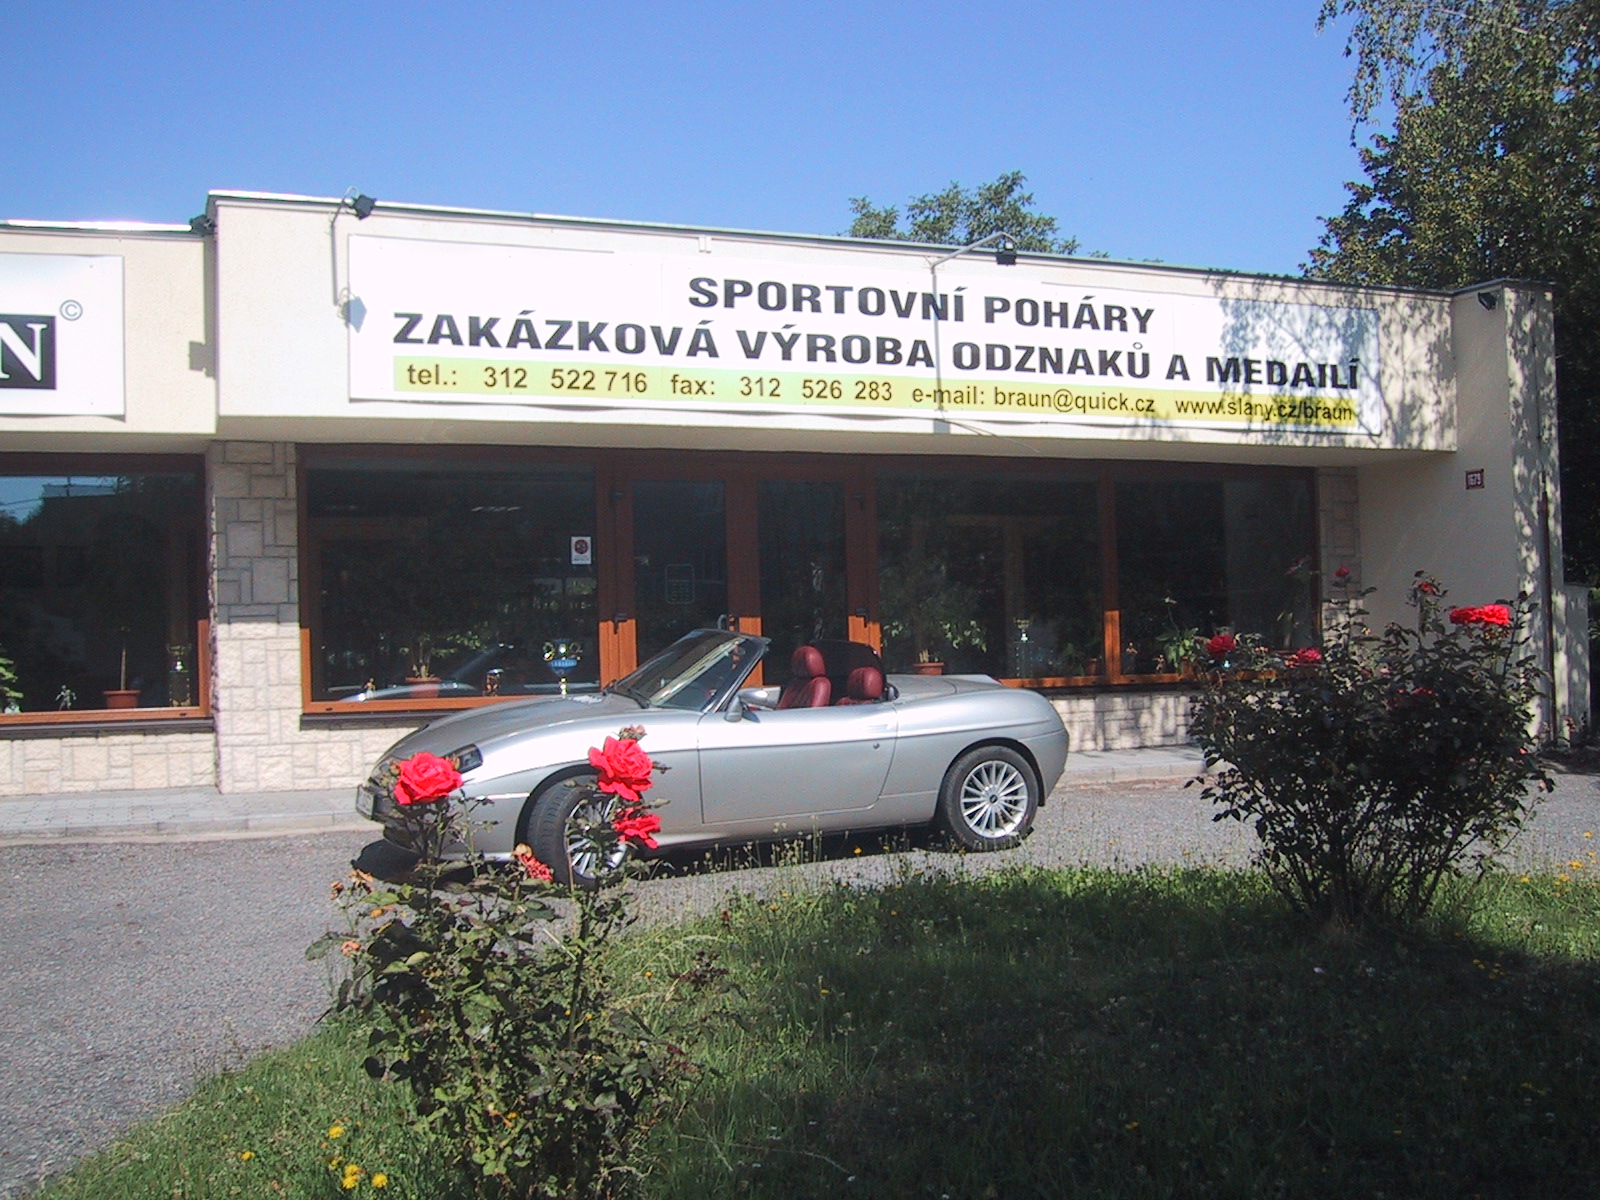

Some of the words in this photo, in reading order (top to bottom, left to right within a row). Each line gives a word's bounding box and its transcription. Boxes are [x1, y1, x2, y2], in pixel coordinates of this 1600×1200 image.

[688, 276, 968, 322] SPORTOVNÍ
[983, 295, 1155, 334] POHÁRY
[392, 309, 720, 358] ZAKÁZKOVÁ
[735, 323, 936, 368] VÝROBA
[952, 341, 1150, 379] ODZNAKŮ
[1165, 354, 1191, 381] A
[1206, 357, 1361, 390] MEDAILÍ
[407, 363, 458, 386] tel.:
[483, 366, 528, 389] 312
[550, 368, 596, 391] 522
[604, 371, 648, 393] 716
[671, 374, 716, 396] fax:
[739, 376, 781, 398] 312
[801, 379, 843, 400] 526
[854, 381, 893, 401] 283
[912, 386, 985, 406] e-mail:
[994, 386, 1156, 414] braun@quick.cz
[1175, 398, 1353, 421] www.slany.cz/braun
